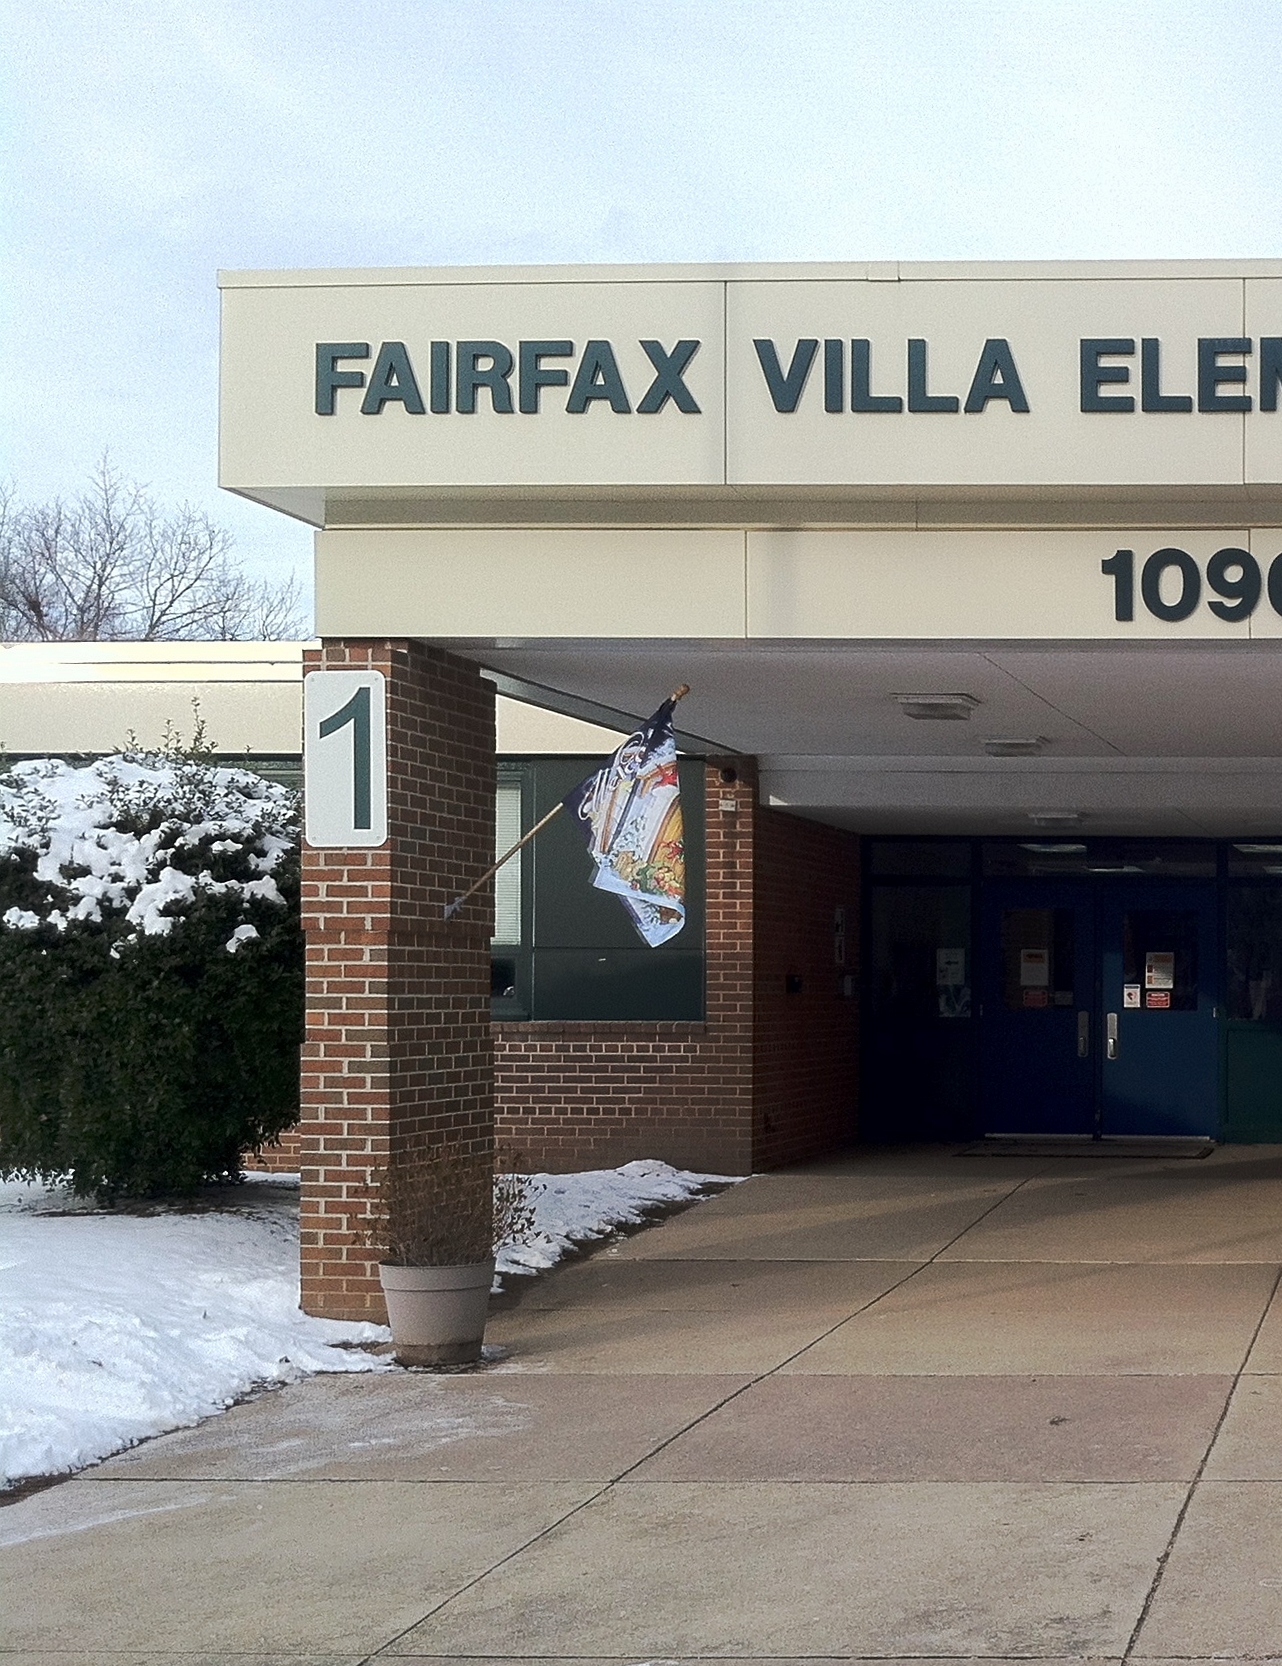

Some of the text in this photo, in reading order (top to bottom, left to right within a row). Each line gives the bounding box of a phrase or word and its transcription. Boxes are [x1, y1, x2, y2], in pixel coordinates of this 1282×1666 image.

[315, 340, 702, 416] FAIRFAX
[752, 338, 1031, 415] VILLA
[319, 687, 371, 830] 1
